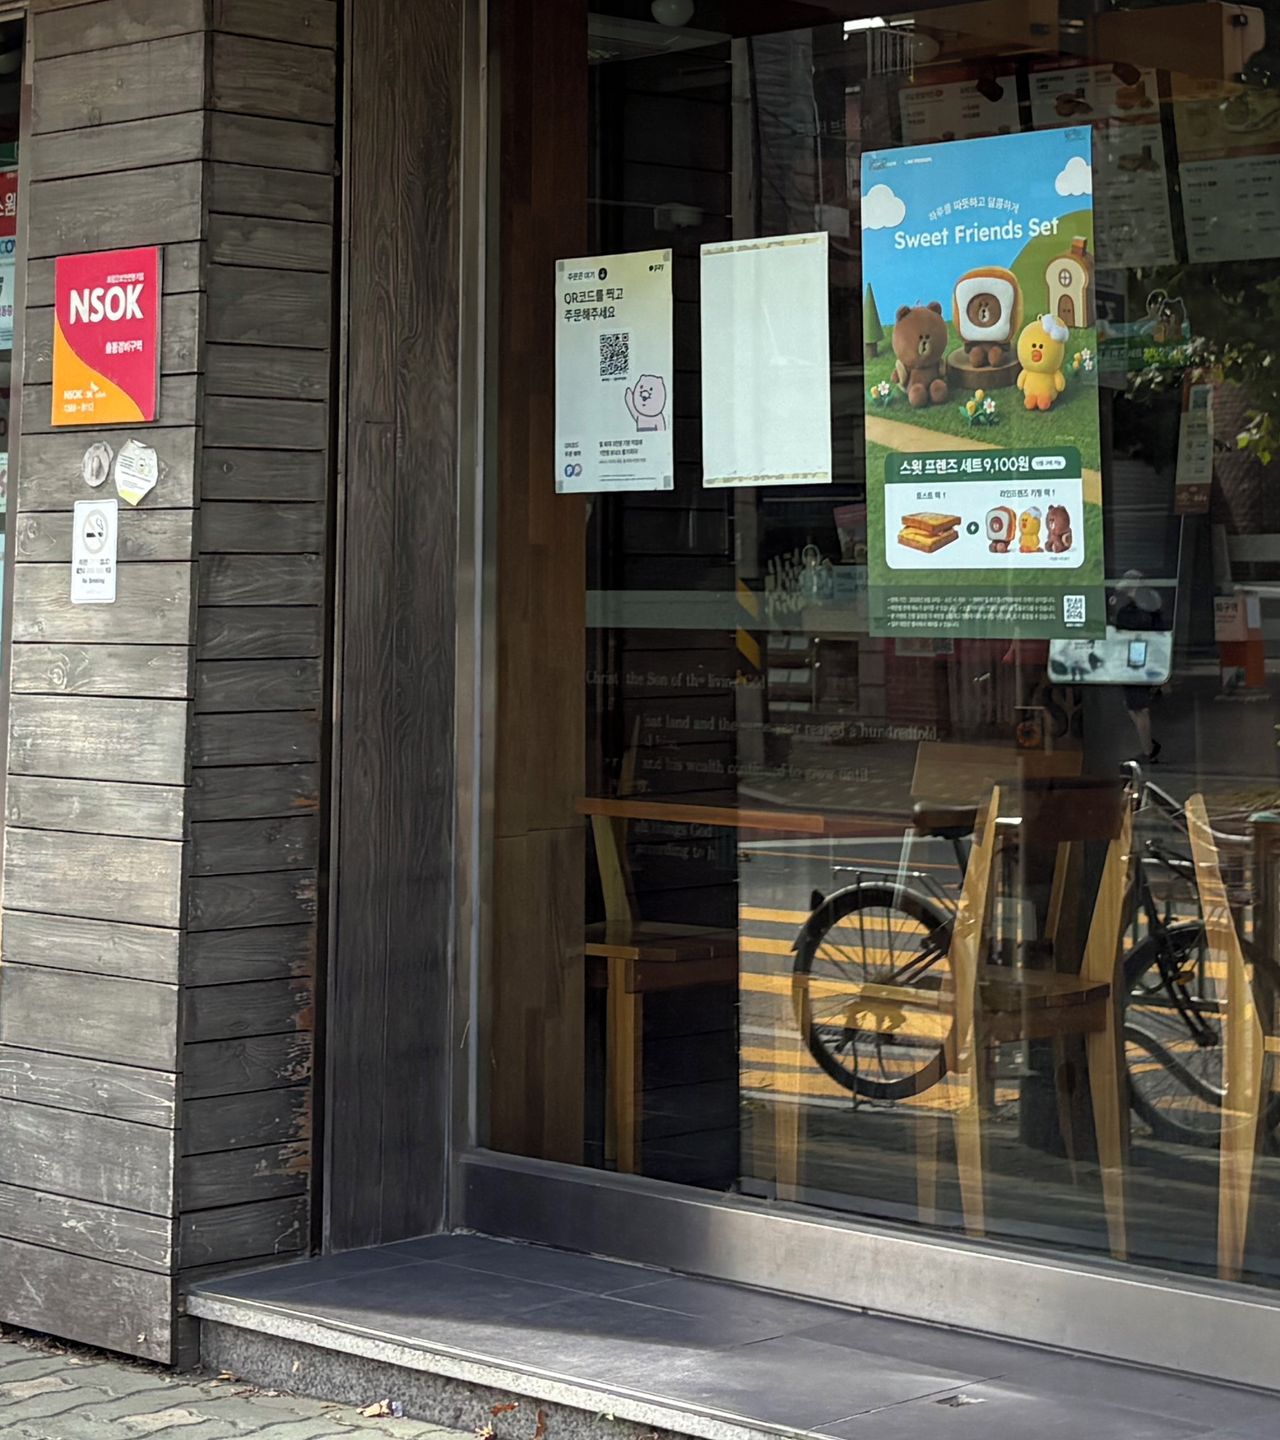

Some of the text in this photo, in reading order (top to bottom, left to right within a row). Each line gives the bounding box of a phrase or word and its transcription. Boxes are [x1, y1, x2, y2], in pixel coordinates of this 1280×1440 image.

[894, 216, 1059, 250] Sweet Friends Set
[69, 284, 144, 325] NSOK
[564, 288, 624, 305] QR코드를 찍고
[564, 306, 616, 322] 주문해주세요
[899, 459, 923, 475] 스윗
[924, 458, 958, 474] 프렌즈
[960, 457, 983, 472] 세트
[983, 455, 1030, 474] 9,100원
